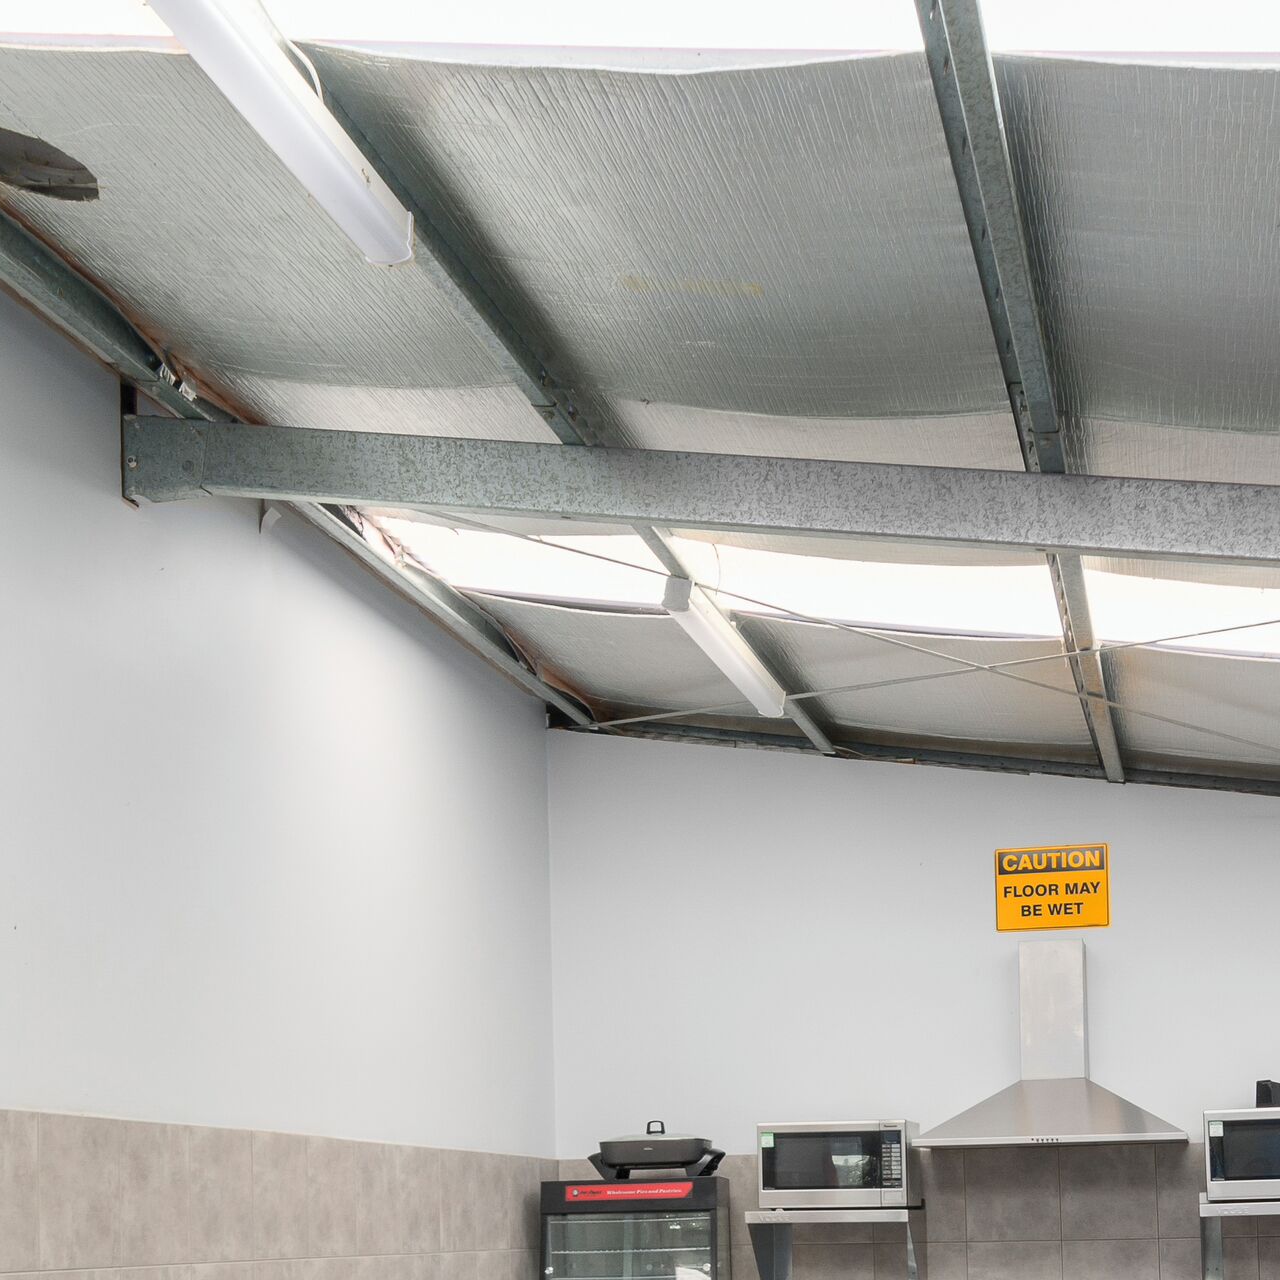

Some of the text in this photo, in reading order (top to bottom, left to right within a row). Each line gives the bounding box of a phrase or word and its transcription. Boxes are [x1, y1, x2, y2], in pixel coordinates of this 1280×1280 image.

[1002, 850, 1100, 872] CAUTION
[1003, 881, 1101, 898] FLOOR MAY
[1021, 902, 1084, 917] BE WET
